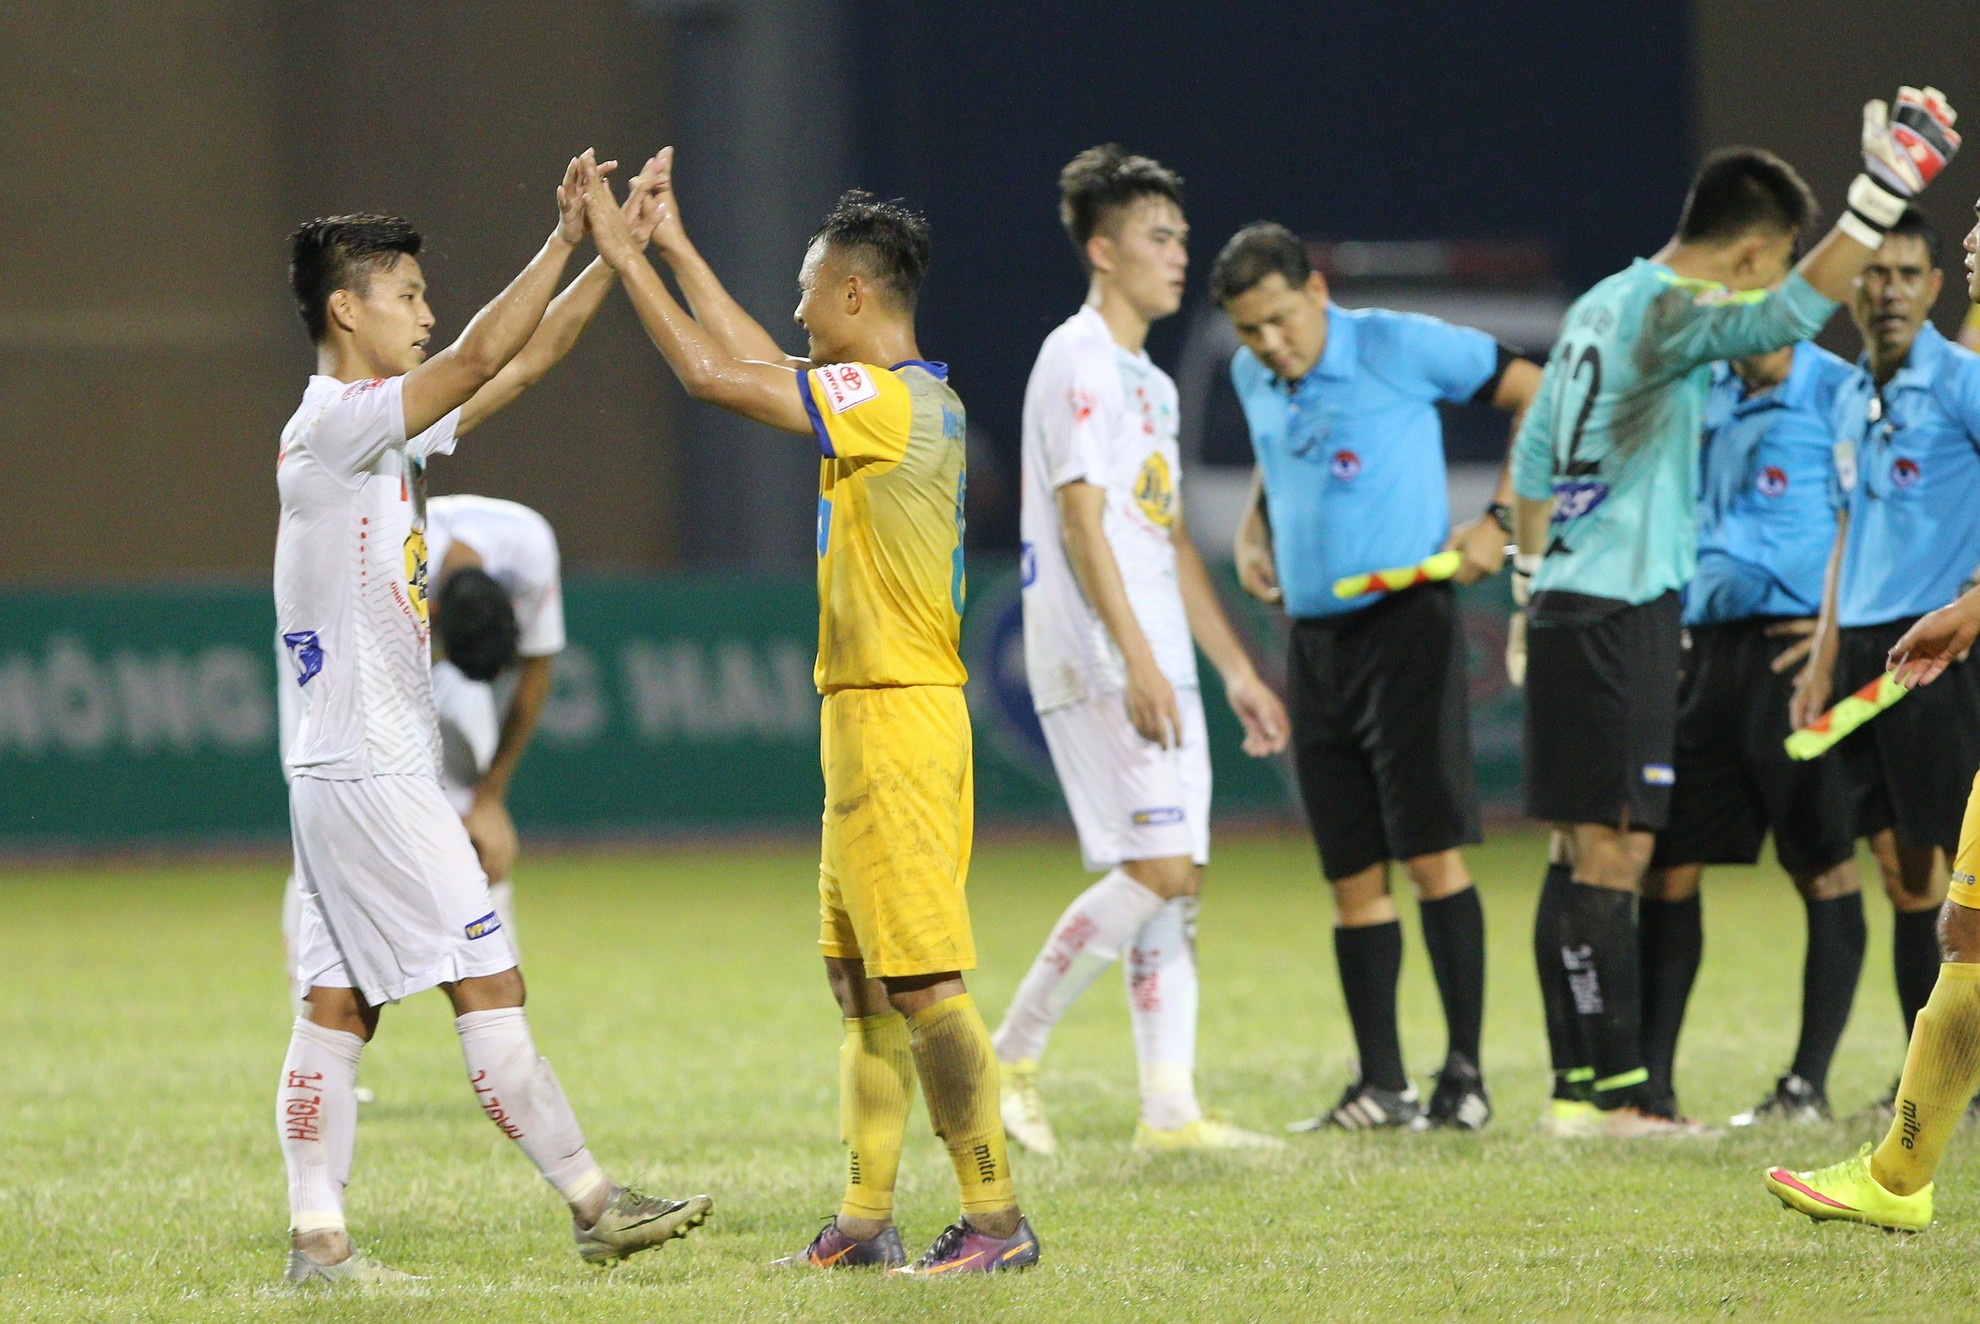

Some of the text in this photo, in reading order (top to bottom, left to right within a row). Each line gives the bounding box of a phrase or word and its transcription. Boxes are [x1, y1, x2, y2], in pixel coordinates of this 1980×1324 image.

[286, 1069, 323, 1142] HAGL FC
[1901, 1099, 1921, 1150] mitre
[973, 1143, 996, 1184] mitre
